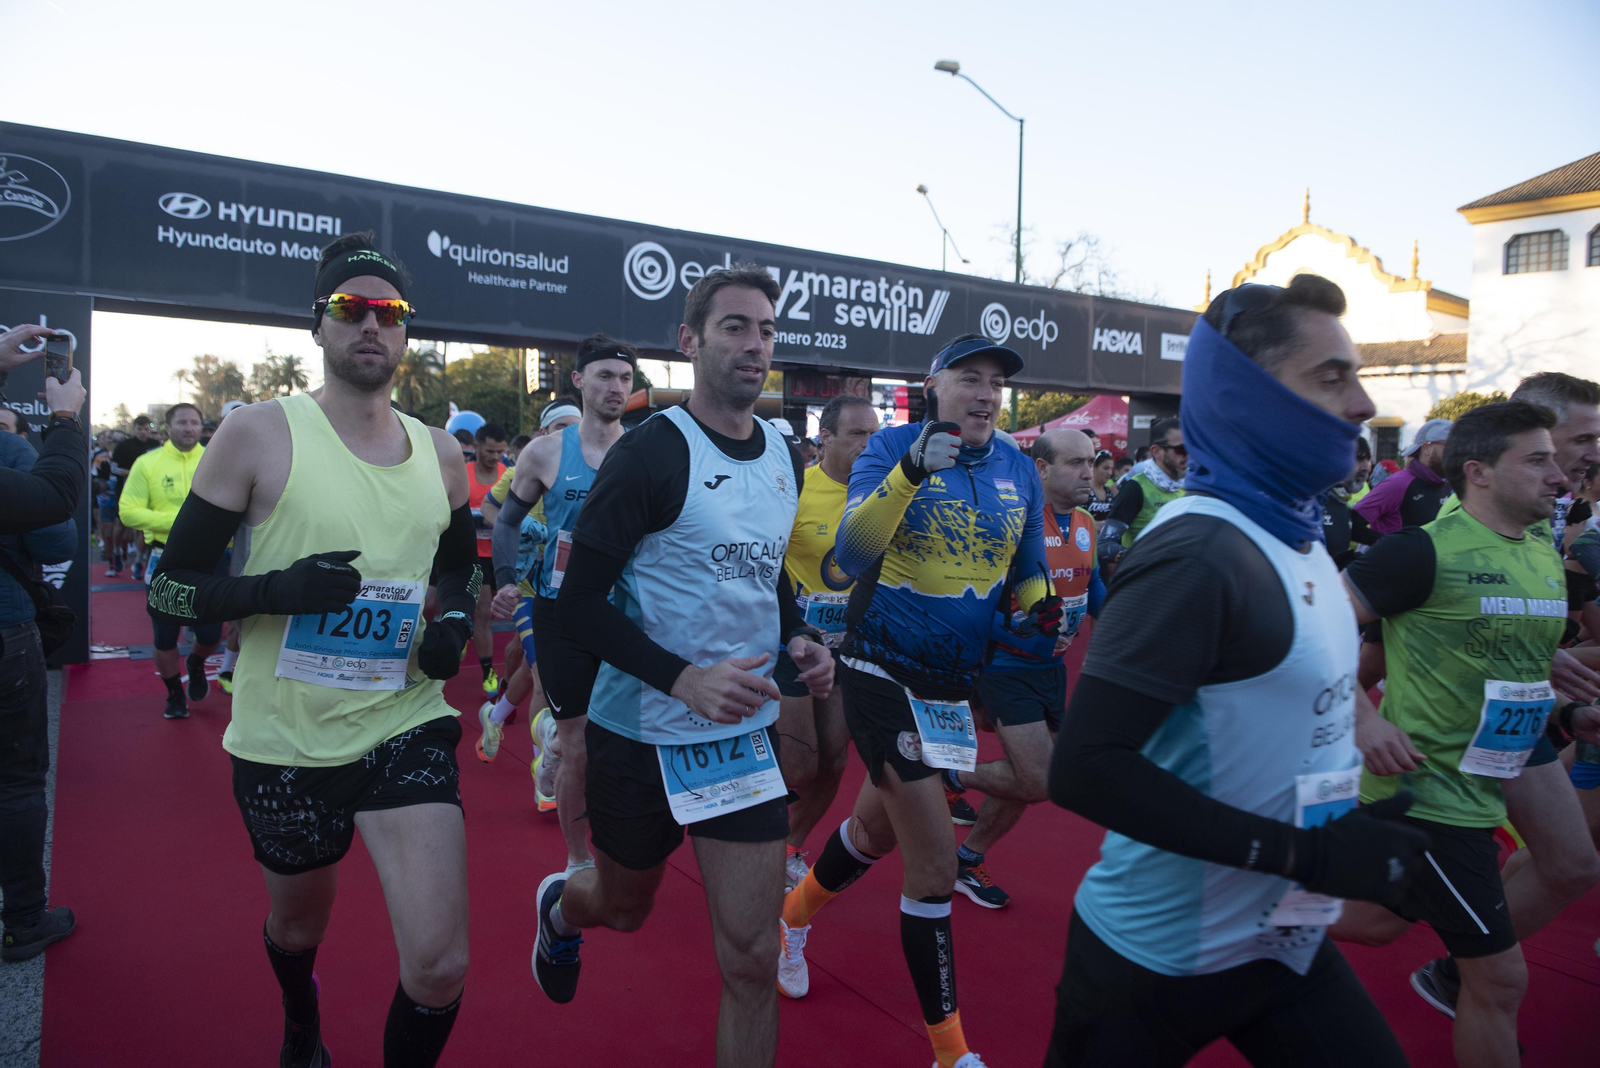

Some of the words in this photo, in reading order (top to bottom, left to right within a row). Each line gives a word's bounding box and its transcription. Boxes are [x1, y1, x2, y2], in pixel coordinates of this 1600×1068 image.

[218, 201, 341, 236] HYUNDAI
[157, 225, 276, 256] Hyundauto
[281, 240, 322, 262] Mot
[468, 271, 527, 290] Healthcare
[529, 279, 568, 295] Partner
[802, 271, 924, 310] maratón
[834, 302, 927, 335] sevilla
[1013, 309, 1059, 350] edp
[815, 332, 847, 349] 2023
[1092, 327, 1143, 356] HOKA
[565, 488, 589, 501] SP
[1045, 536, 1063, 547] NIO
[367, 584, 406, 594] maratón
[1467, 573, 1508, 585] HOKA
[317, 606, 392, 641] 1203
[295, 642, 312, 650] Juan
[314, 645, 342, 654] Enrique
[344, 648, 367, 657] Molino
[347, 658, 367, 671] edp
[924, 706, 964, 732] 1659
[676, 736, 745, 772] 1612
[257, 785, 292, 794] NIKE
[721, 780, 740, 794] edp
